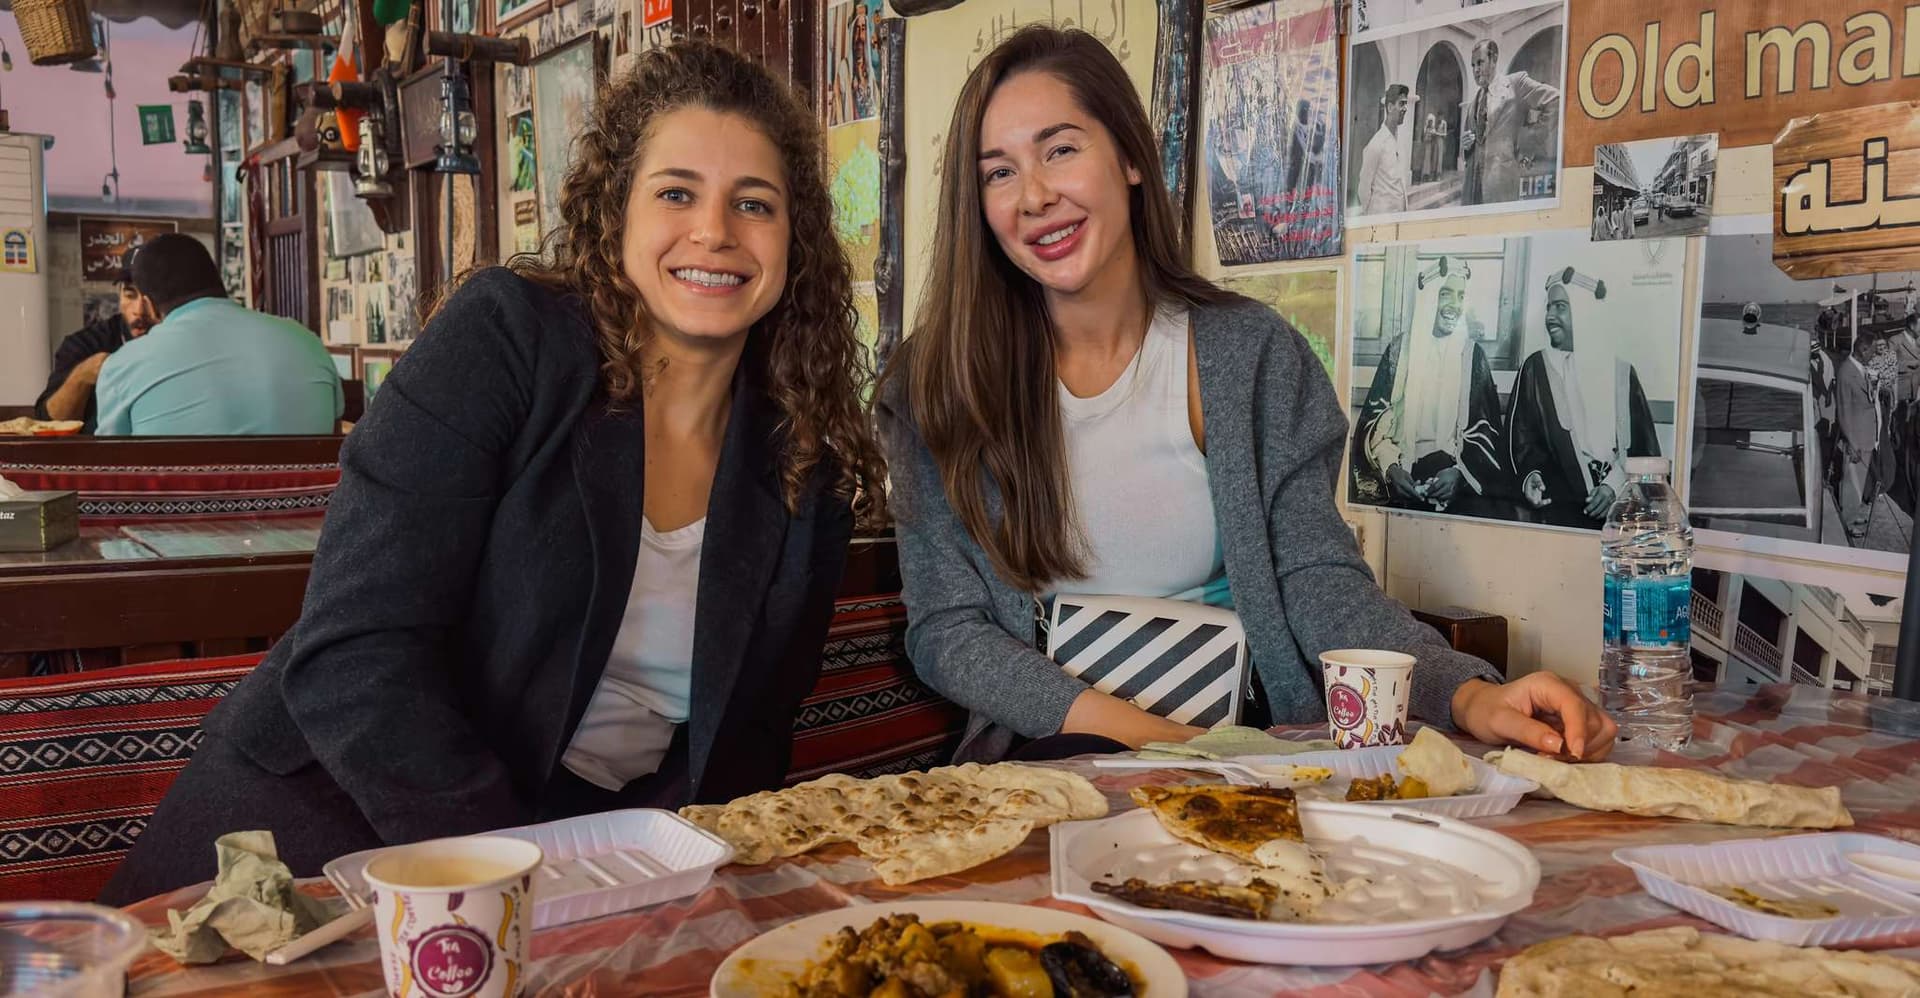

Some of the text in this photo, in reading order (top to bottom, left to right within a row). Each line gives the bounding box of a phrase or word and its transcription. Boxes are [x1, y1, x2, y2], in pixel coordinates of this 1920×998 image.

[1577, 9, 1717, 121] Old
[1519, 174, 1553, 197] LIFE
[1782, 136, 1920, 238] نه
[427, 964, 474, 982] Coffee
